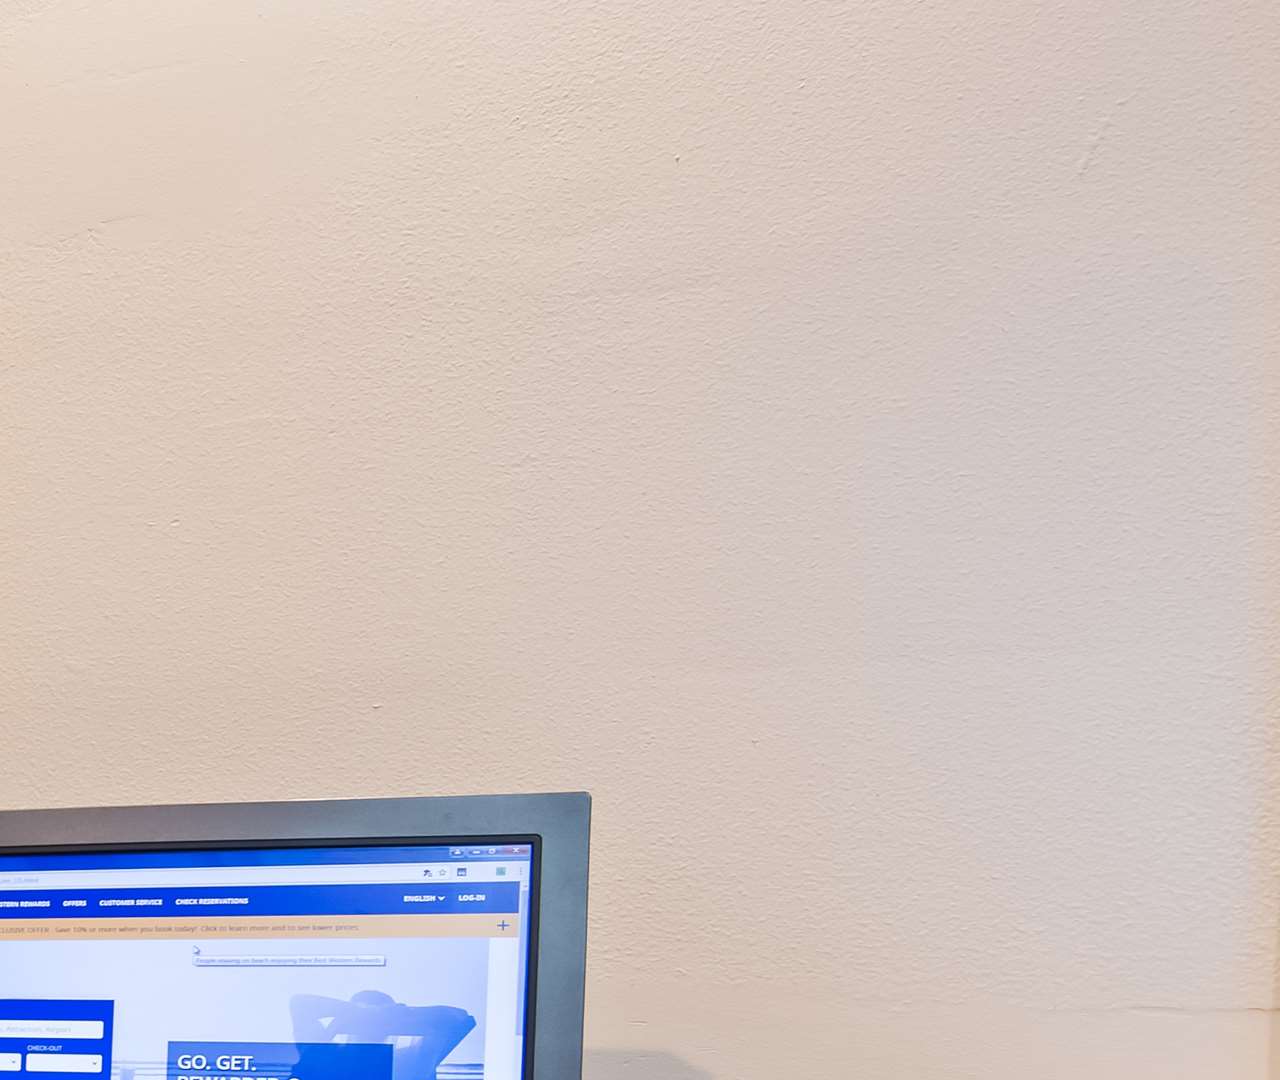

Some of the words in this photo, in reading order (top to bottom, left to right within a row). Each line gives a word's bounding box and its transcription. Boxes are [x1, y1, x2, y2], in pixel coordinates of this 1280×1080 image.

[175, 898, 198, 906] CHECK
[458, 894, 486, 902] LOG-IN
[20, 900, 50, 908] REWARDS
[177, 1054, 211, 1070] GO.
[216, 1055, 257, 1071] GET.
